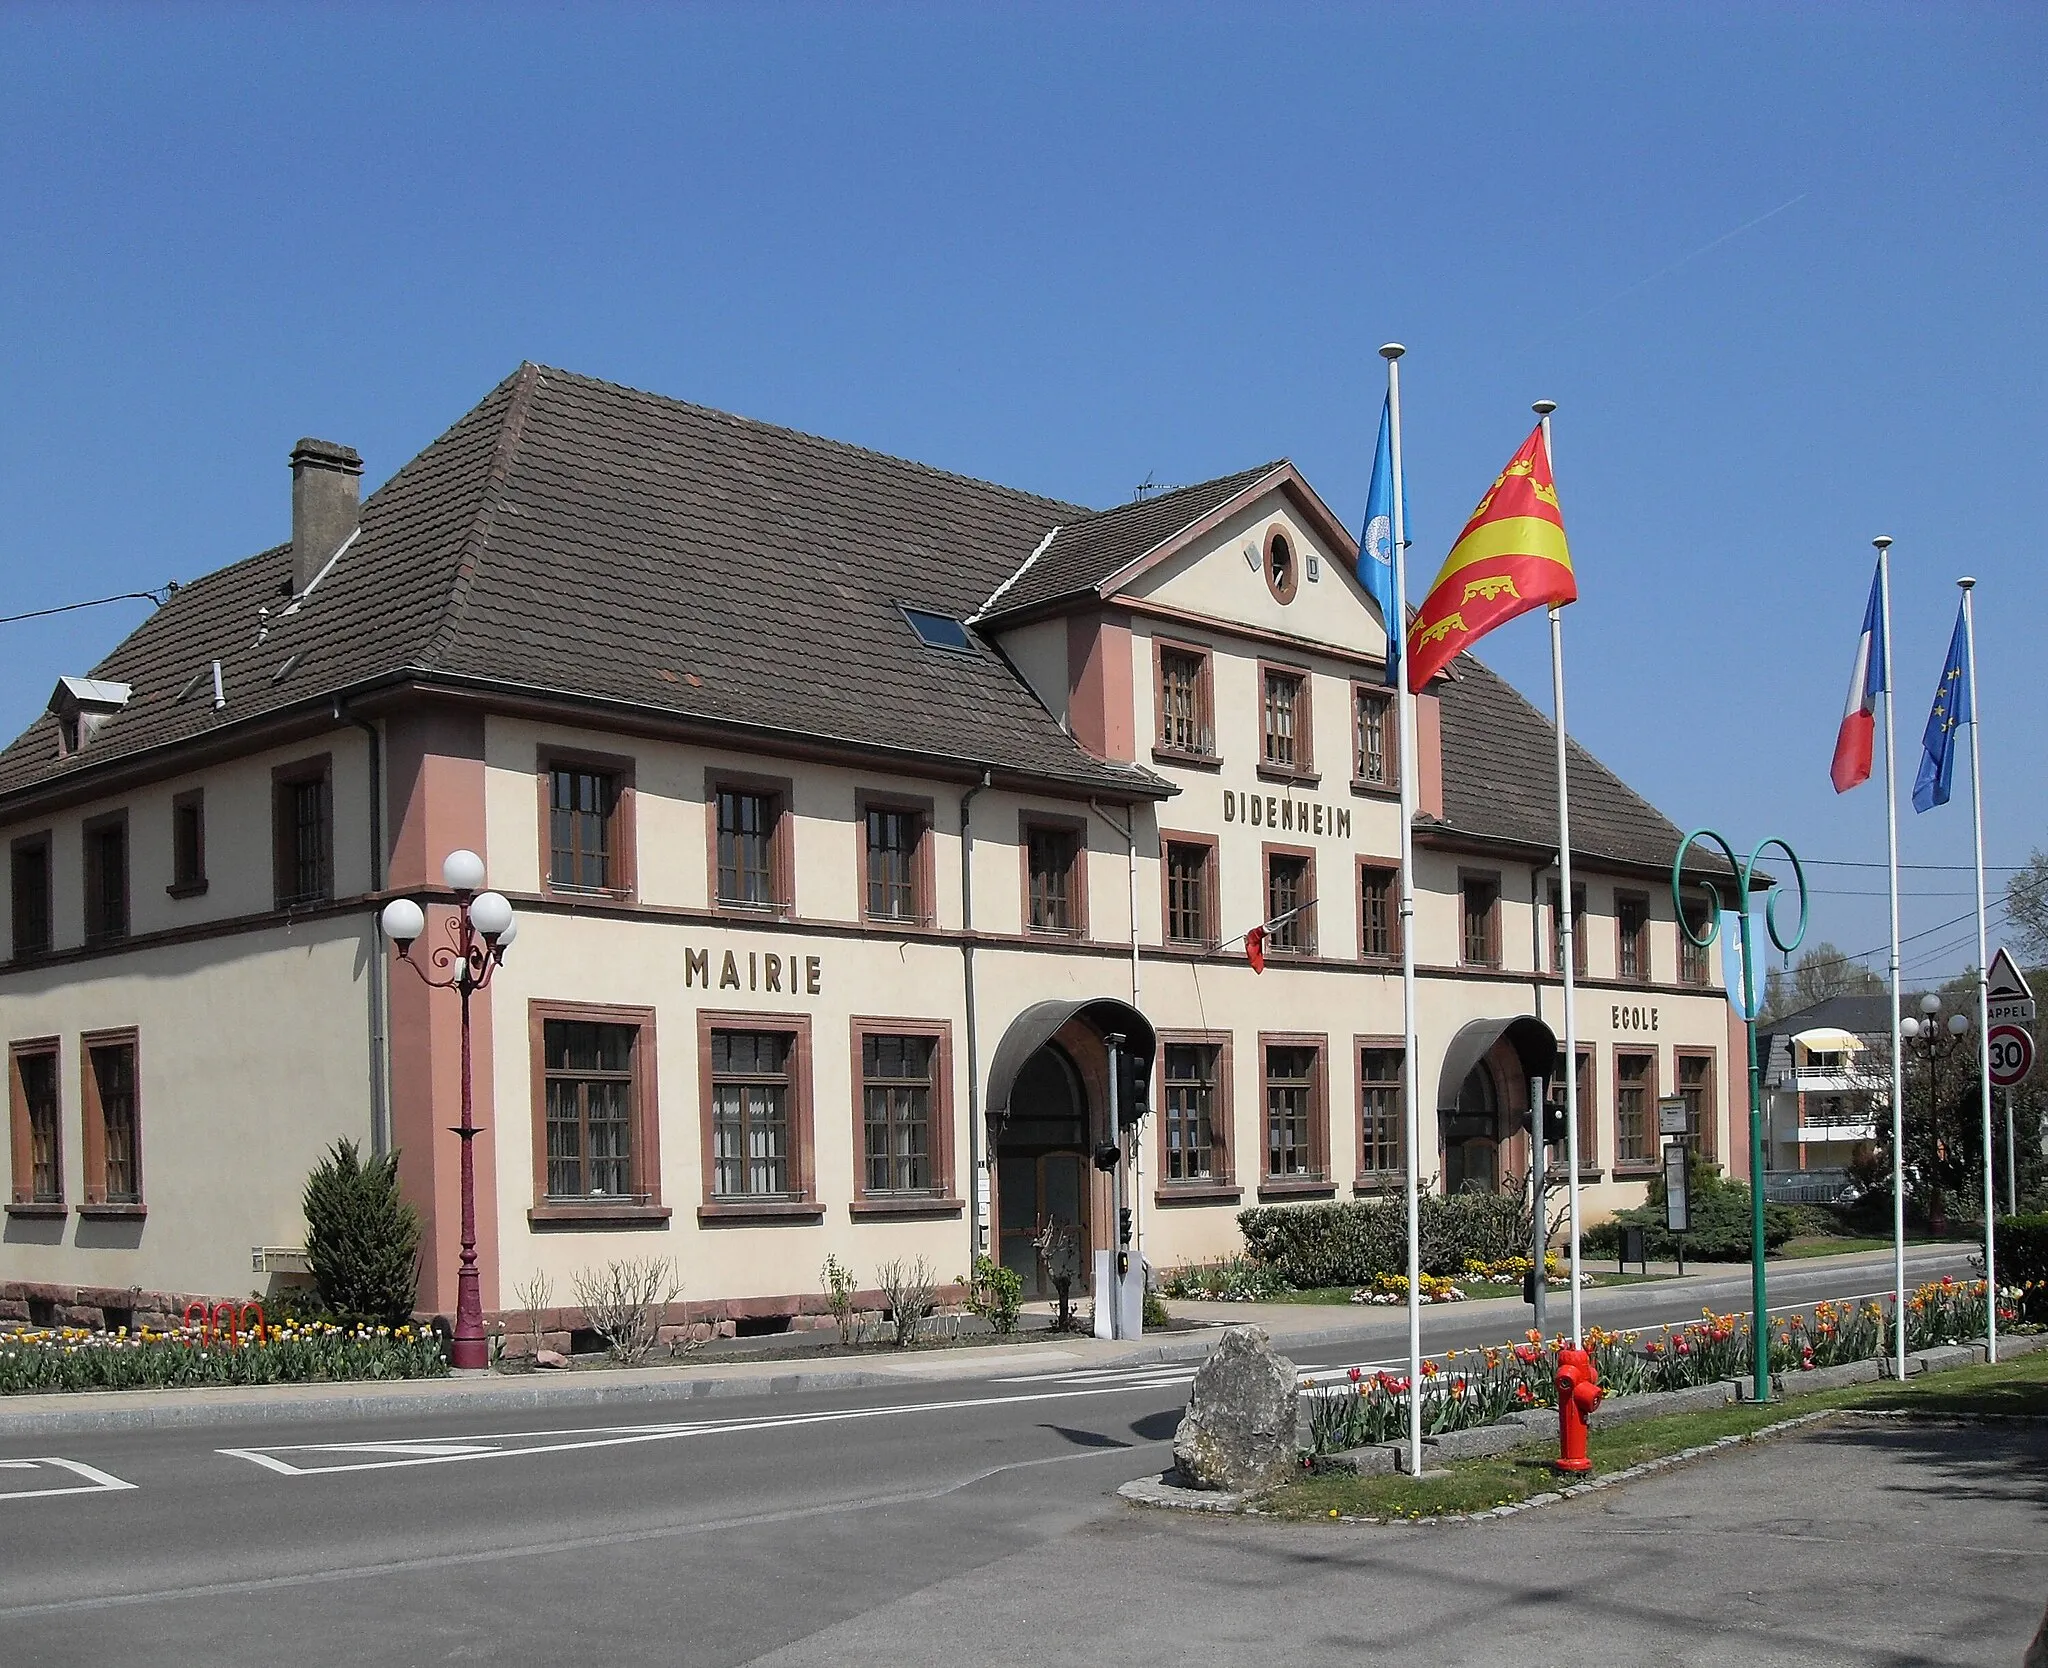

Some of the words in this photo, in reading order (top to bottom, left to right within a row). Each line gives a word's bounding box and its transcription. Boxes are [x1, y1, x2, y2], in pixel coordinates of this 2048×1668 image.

[1223, 789, 1351, 839] DIDENHEIM
[685, 947, 821, 995] MAIRIE
[1611, 1005, 1659, 1031] ECOLE
[1988, 1006, 2027, 1019] APPEL
[1989, 1041, 2023, 1070] 30
